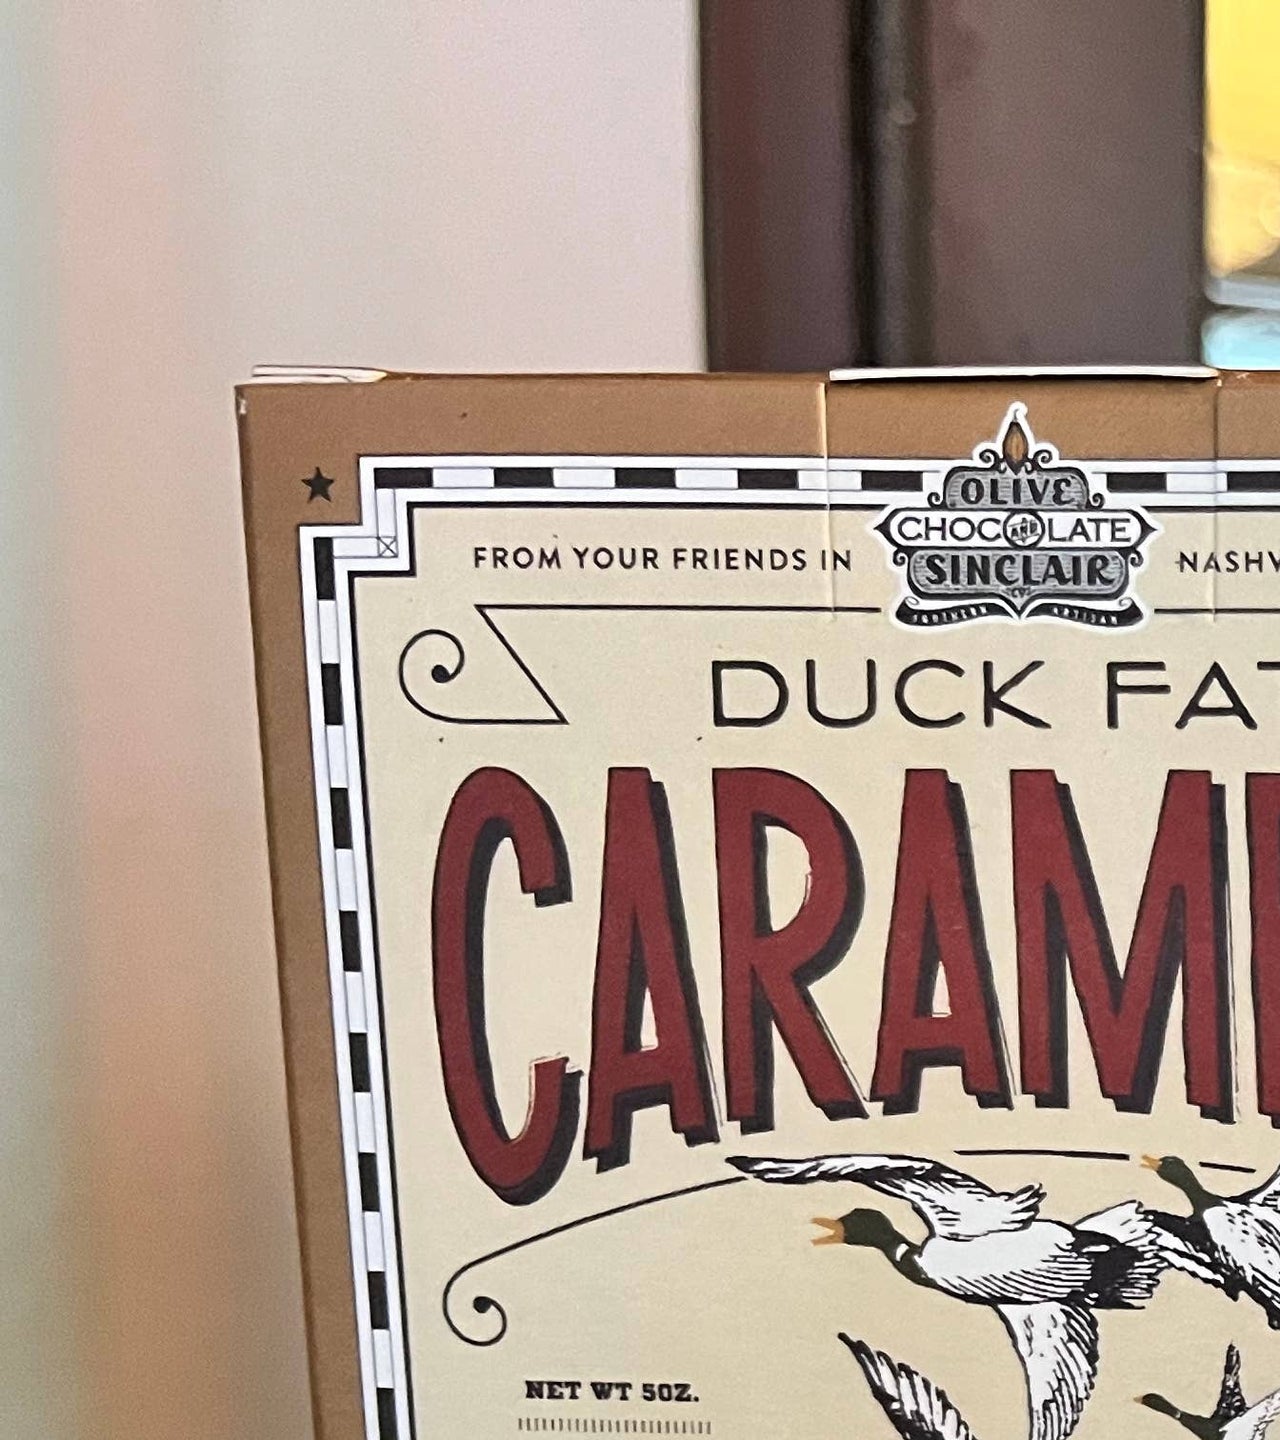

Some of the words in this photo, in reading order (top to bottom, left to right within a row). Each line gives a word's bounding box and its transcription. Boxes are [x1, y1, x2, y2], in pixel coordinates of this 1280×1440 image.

[960, 477, 1073, 505] OLIVE
[473, 546, 561, 571] FROM
[572, 546, 661, 572] YOUR
[672, 548, 806, 573] FRIENDS
[820, 549, 852, 572] IN
[925, 553, 1116, 586] SINCLAIR
[712, 659, 1052, 730] DUCK
[525, 1380, 582, 1400] NET
[590, 1382, 632, 1401] WT
[642, 1383, 700, 1403] 5OZ.
